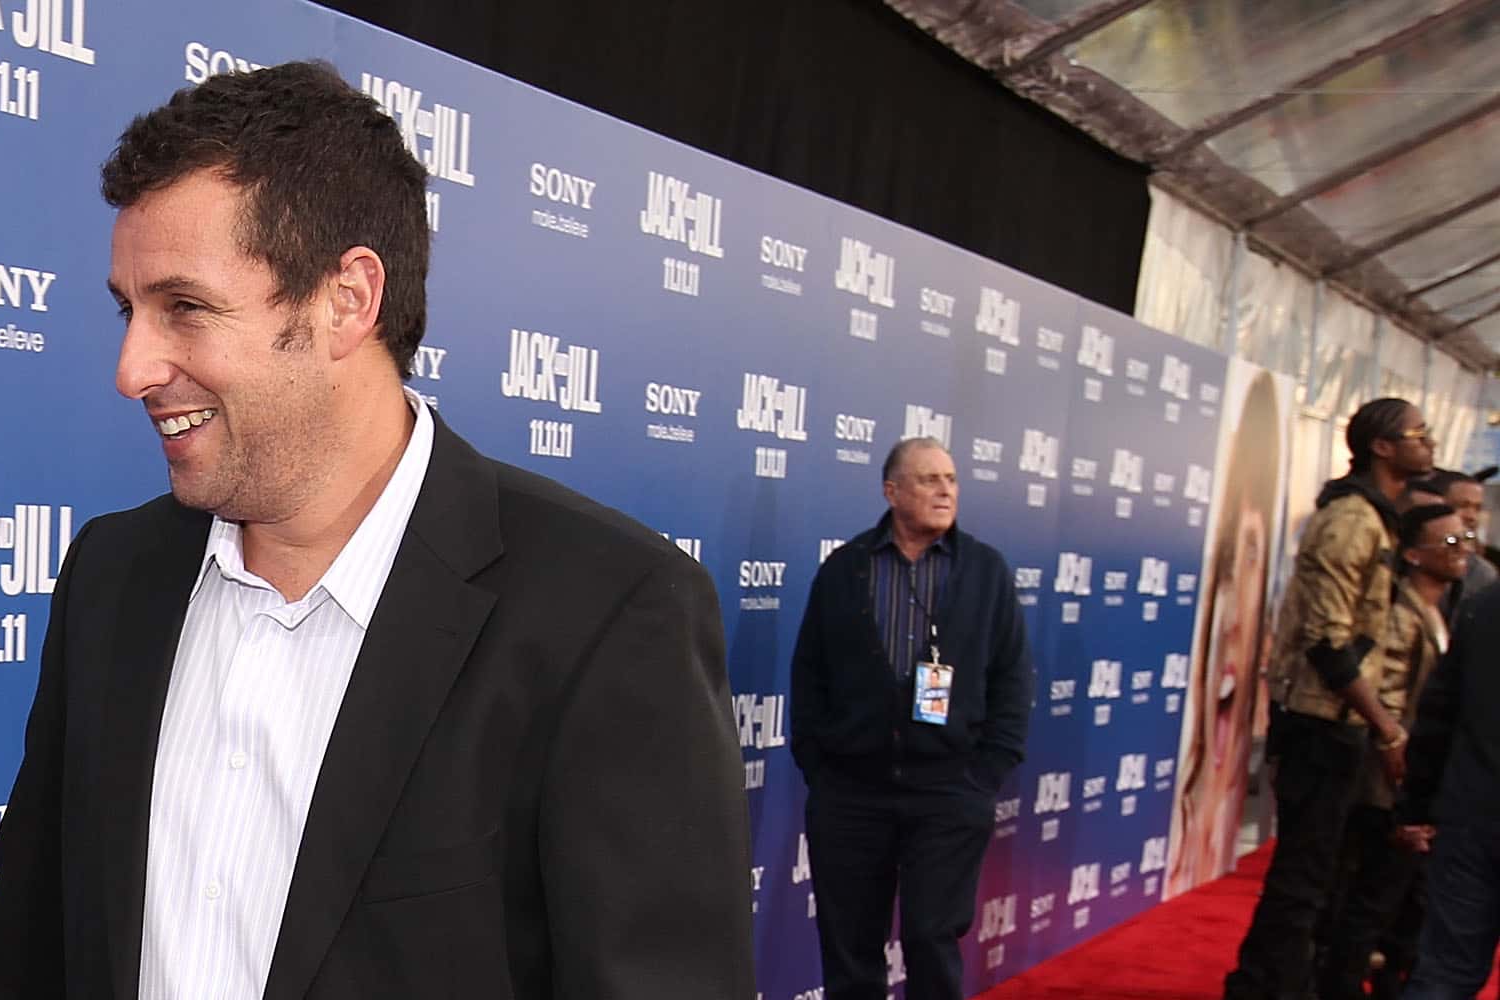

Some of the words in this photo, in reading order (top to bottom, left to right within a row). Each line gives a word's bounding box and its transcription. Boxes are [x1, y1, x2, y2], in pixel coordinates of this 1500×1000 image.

[531, 163, 597, 209] SONY
[501, 328, 560, 402] JACK
[645, 382, 701, 417] SONY
